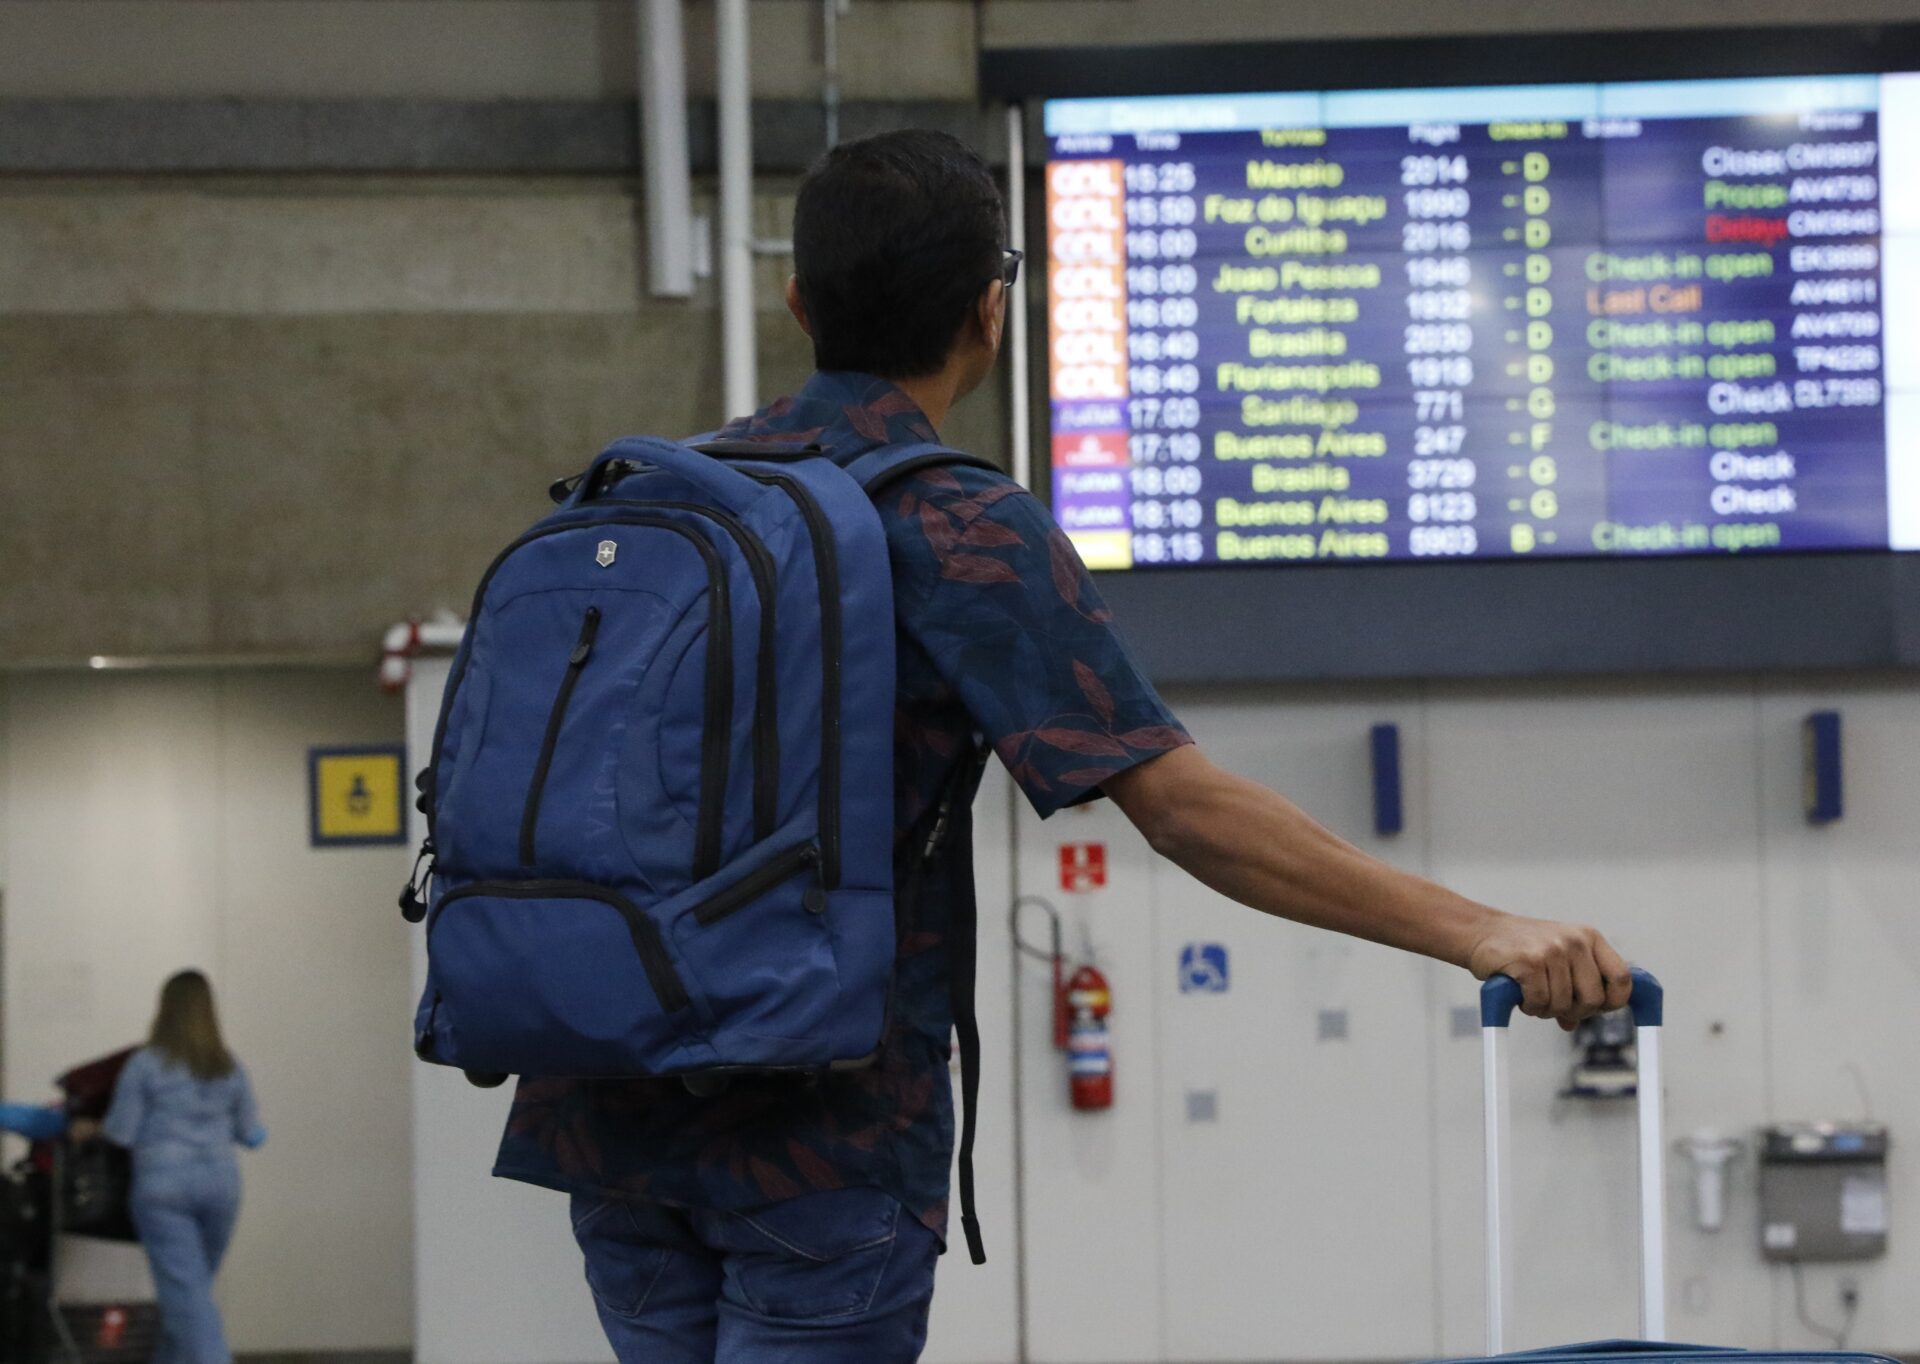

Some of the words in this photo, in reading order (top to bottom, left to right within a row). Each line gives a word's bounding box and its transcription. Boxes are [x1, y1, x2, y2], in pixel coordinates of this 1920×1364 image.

[1586, 252, 1700, 281] Check-in
[1705, 254, 1772, 283] open
[1587, 287, 1645, 315] Last
[1649, 285, 1701, 313] Call
[1587, 320, 1703, 349] Check-in
[1707, 321, 1774, 349] open
[1588, 353, 1704, 382] Check-in
[1708, 354, 1775, 381] open
[1242, 396, 1358, 427] Santiago
[1414, 391, 1462, 420] 771
[1708, 382, 1792, 414] Check
[1215, 432, 1313, 460] Buenos
[1317, 430, 1386, 457] Aires
[1414, 426, 1465, 455] 247
[1590, 421, 1705, 450] Check-in
[1710, 423, 1777, 450] open
[1710, 451, 1794, 481] Check
[1216, 498, 1314, 526] Buenos
[1318, 497, 1388, 523] Aires
[1711, 485, 1796, 515] Check
[1217, 532, 1315, 559] Buenos
[1319, 530, 1389, 557] Aires
[1592, 522, 1708, 550] Check-in
[1712, 523, 1780, 552] open
